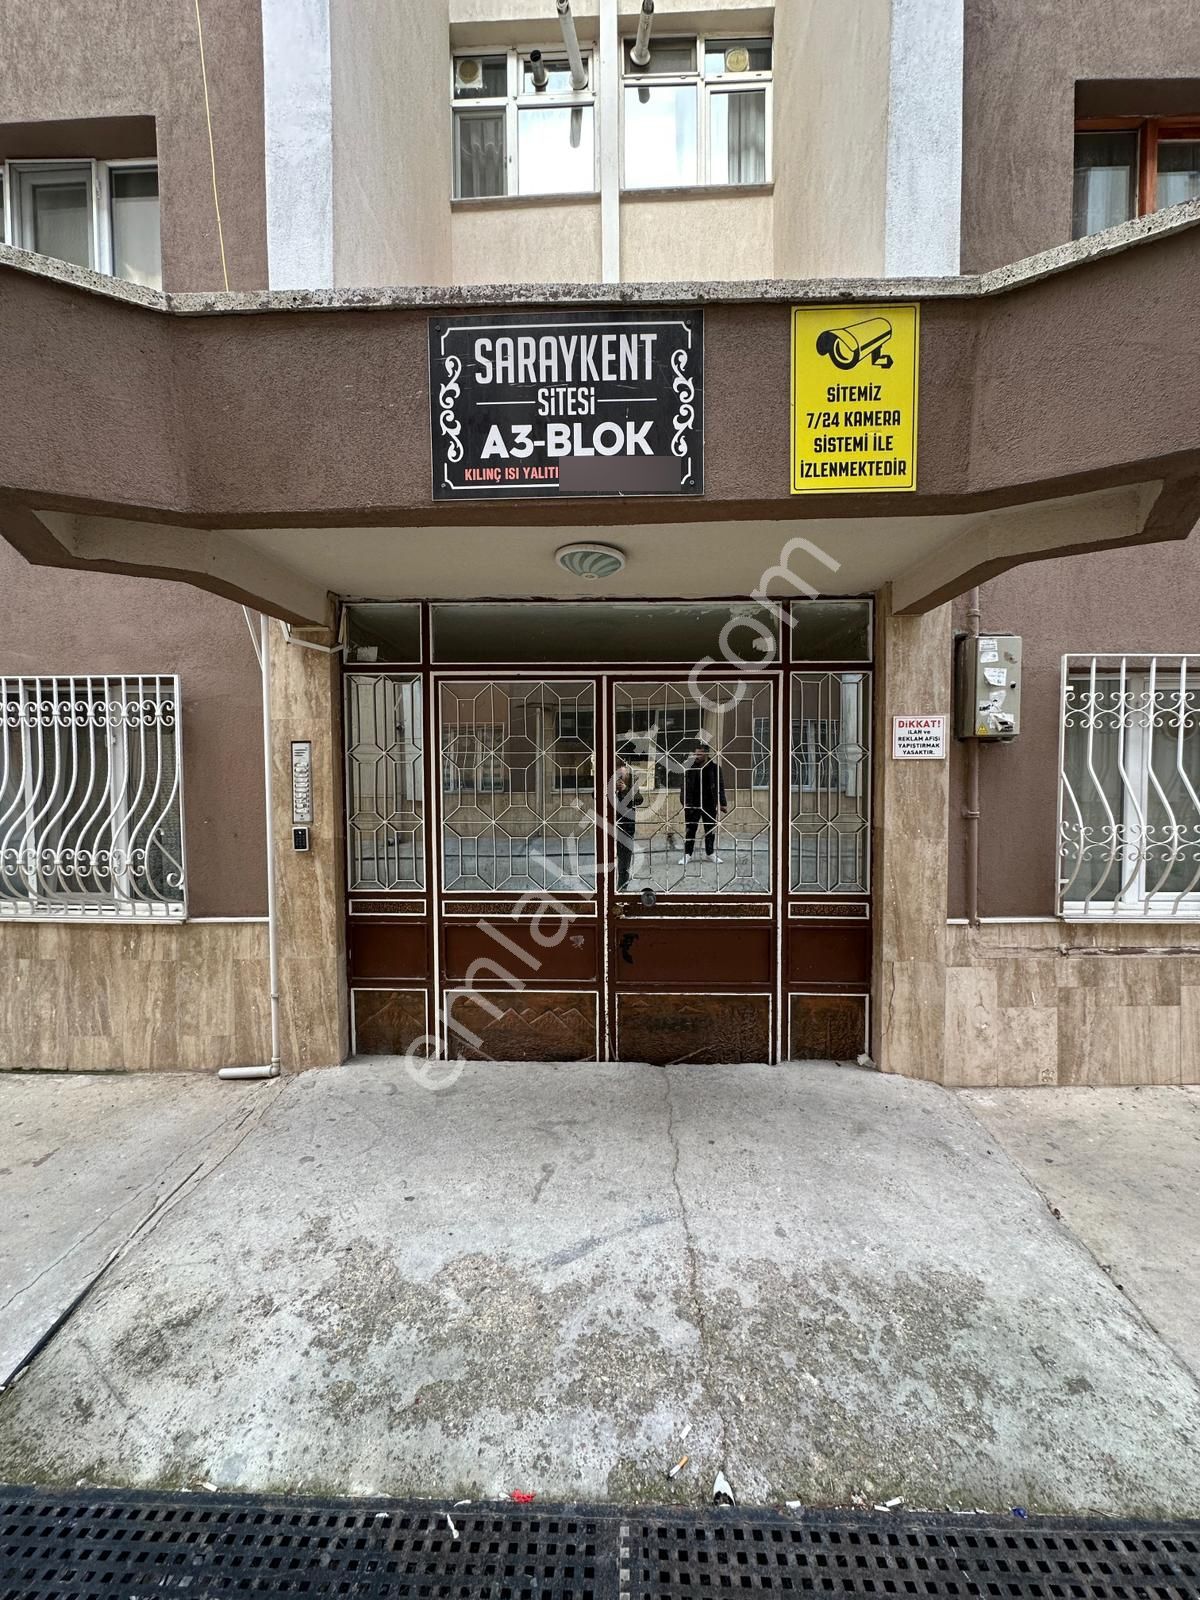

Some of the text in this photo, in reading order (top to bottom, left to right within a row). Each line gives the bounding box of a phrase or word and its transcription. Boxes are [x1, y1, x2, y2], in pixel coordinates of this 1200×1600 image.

[474, 333, 658, 384] SARAYKENT
[827, 382, 882, 403] SİTEMİZ
[806, 410, 901, 429] 7/24 KAMERA
[480, 420, 655, 460] A3-BLOK
[814, 433, 894, 453] SİSTEMİ İLE
[464, 466, 559, 483] KILINÇ ISI YALITI
[800, 457, 907, 478] İZLENMEKTEDİR
